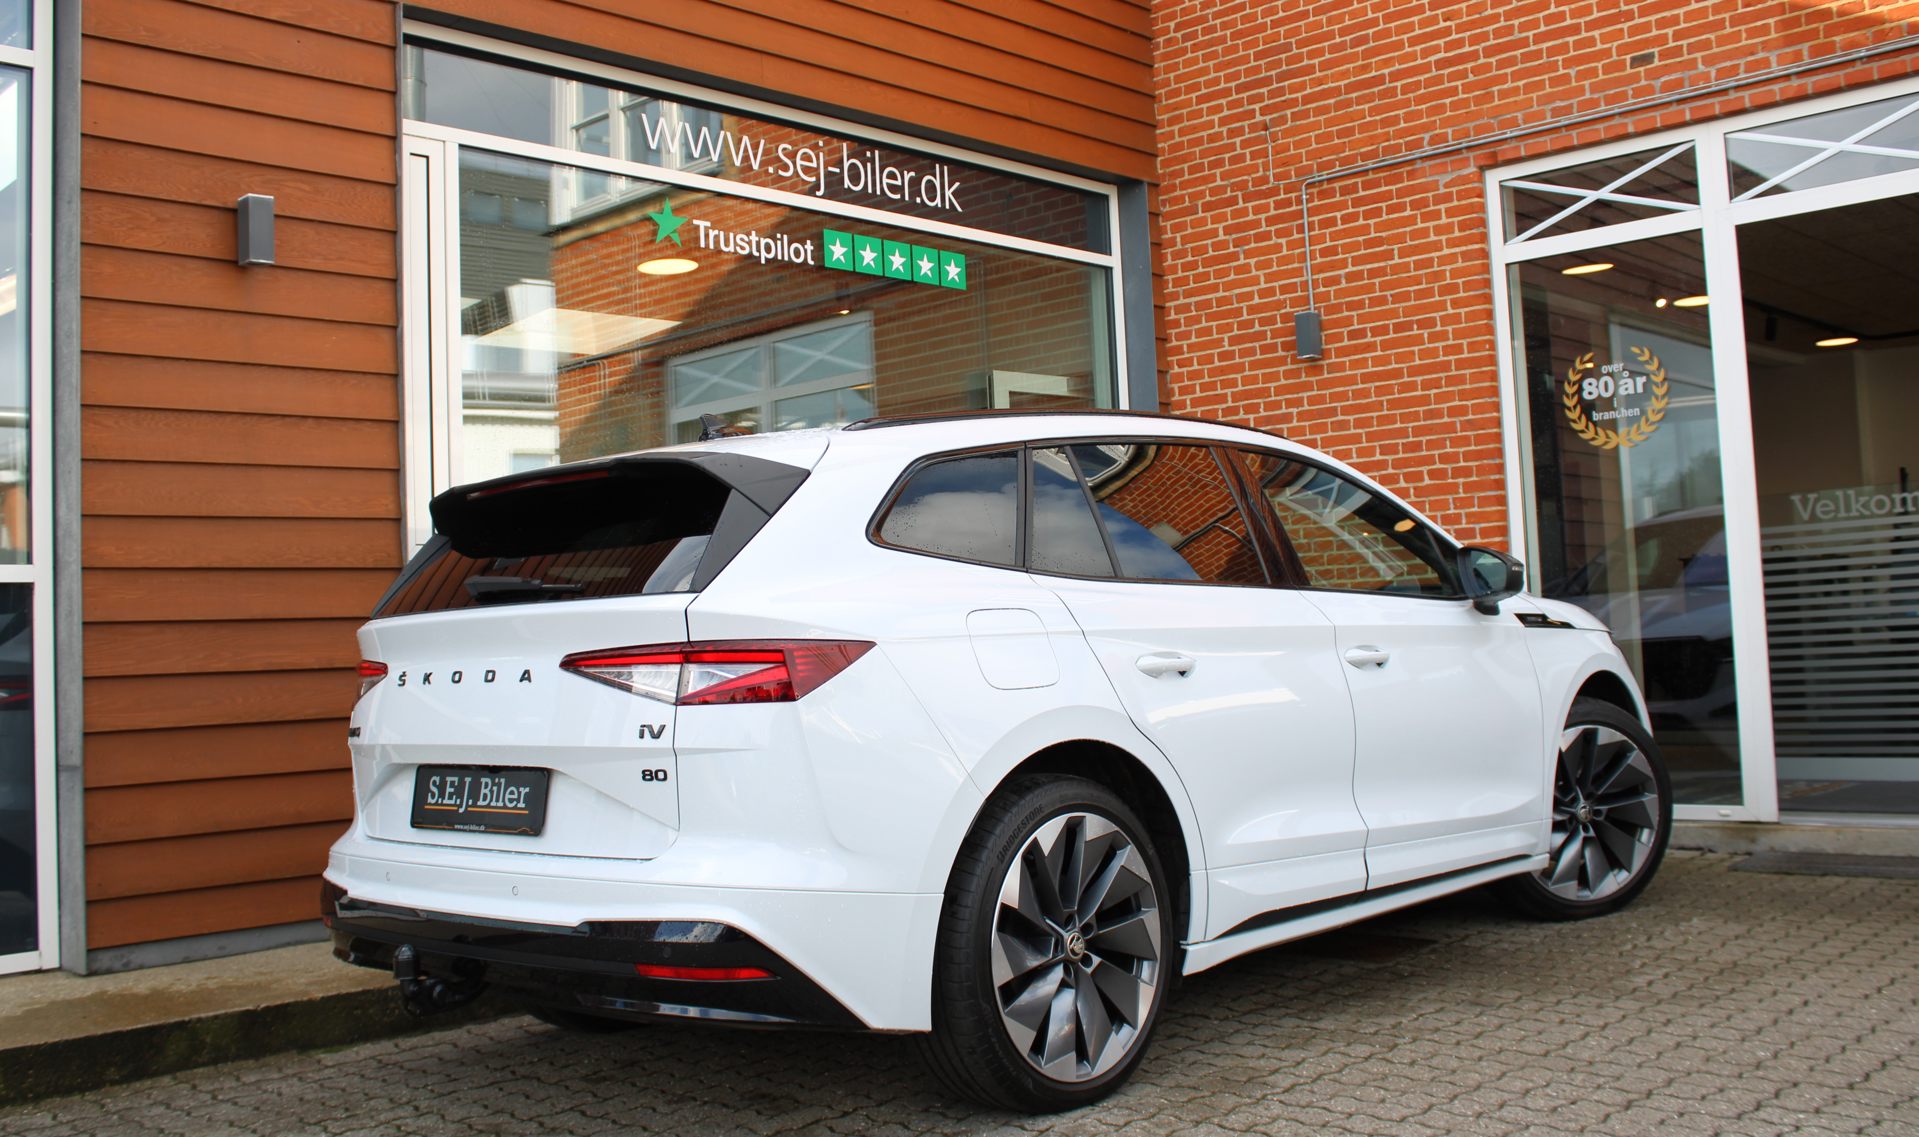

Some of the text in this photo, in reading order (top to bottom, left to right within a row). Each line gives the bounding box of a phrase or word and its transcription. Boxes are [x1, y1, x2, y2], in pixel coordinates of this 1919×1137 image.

[641, 113, 963, 212] www.sej-biler.dk
[692, 219, 815, 265] Trustpilot
[1601, 362, 1624, 374] over
[1582, 371, 1647, 400] 80 år
[1592, 407, 1640, 421] branchen
[641, 769, 668, 782] 80
[427, 775, 529, 813] S.E.J. Biler
